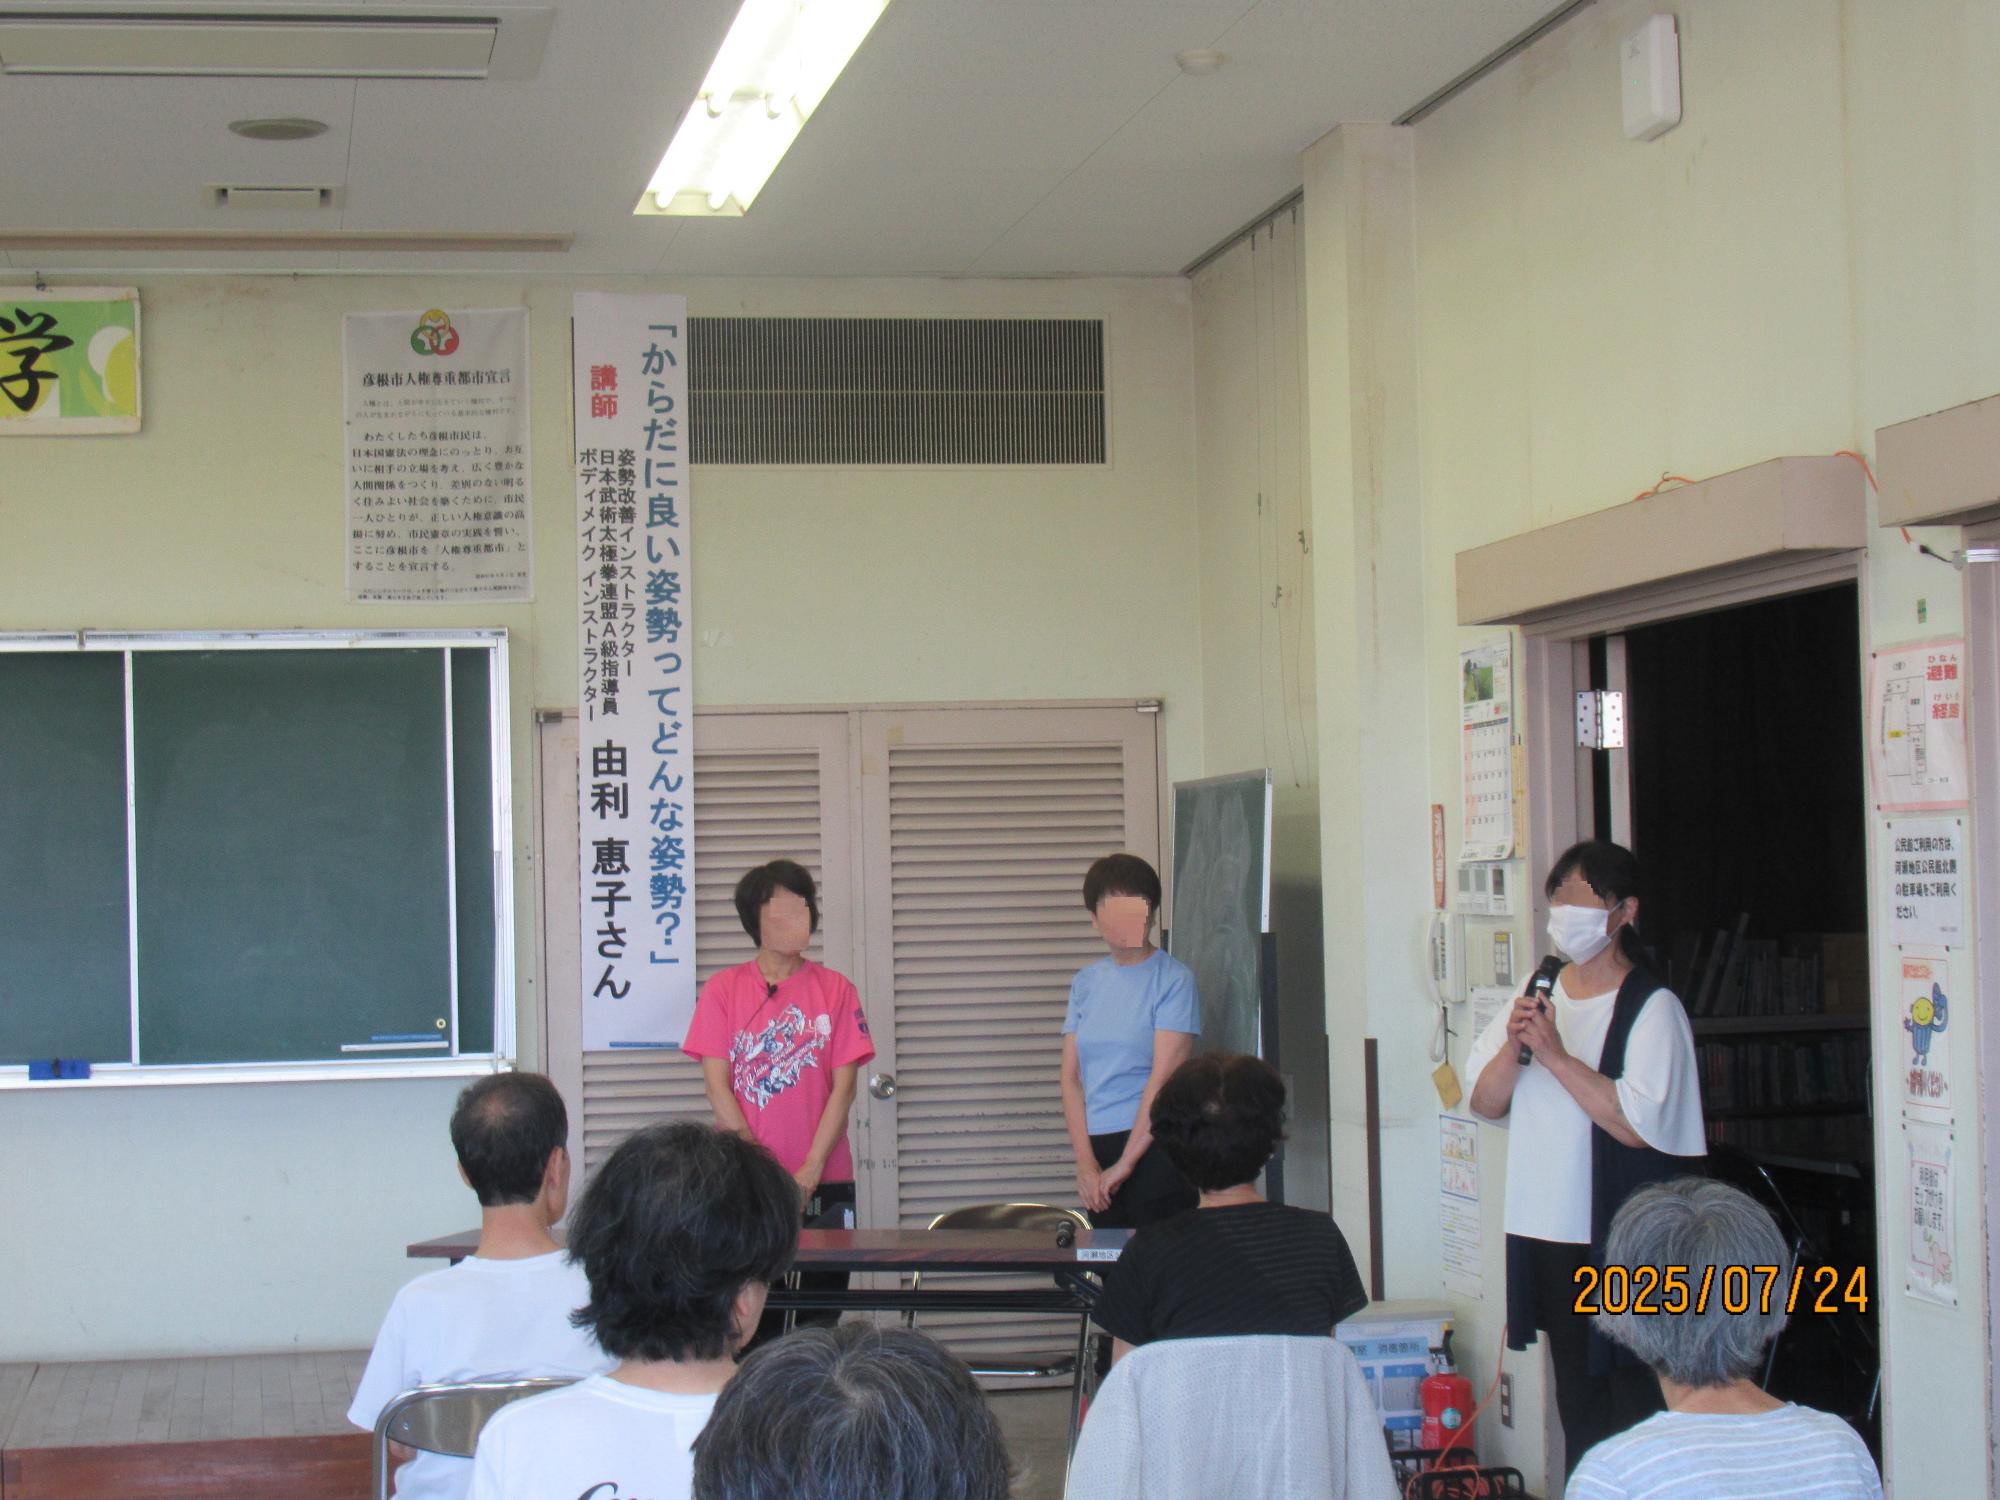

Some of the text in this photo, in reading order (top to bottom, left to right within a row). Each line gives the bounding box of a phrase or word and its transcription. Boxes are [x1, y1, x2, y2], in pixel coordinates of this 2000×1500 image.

[362, 367, 511, 388] 彦根市人権尊重都市宣言
[591, 363, 618, 420] 講師
[579, 447, 599, 722] ボディメイク インストラクター
[600, 448, 619, 716] 日本武術太極拳連盟A級指導員
[618, 448, 637, 677] 姿勢改善インストラクター
[641, 323, 687, 964] 「からだに良い姿勢ってどんな姿勢？」
[1926, 663, 1958, 681] 避難
[590, 739, 632, 1000] 由利 恵子さん
